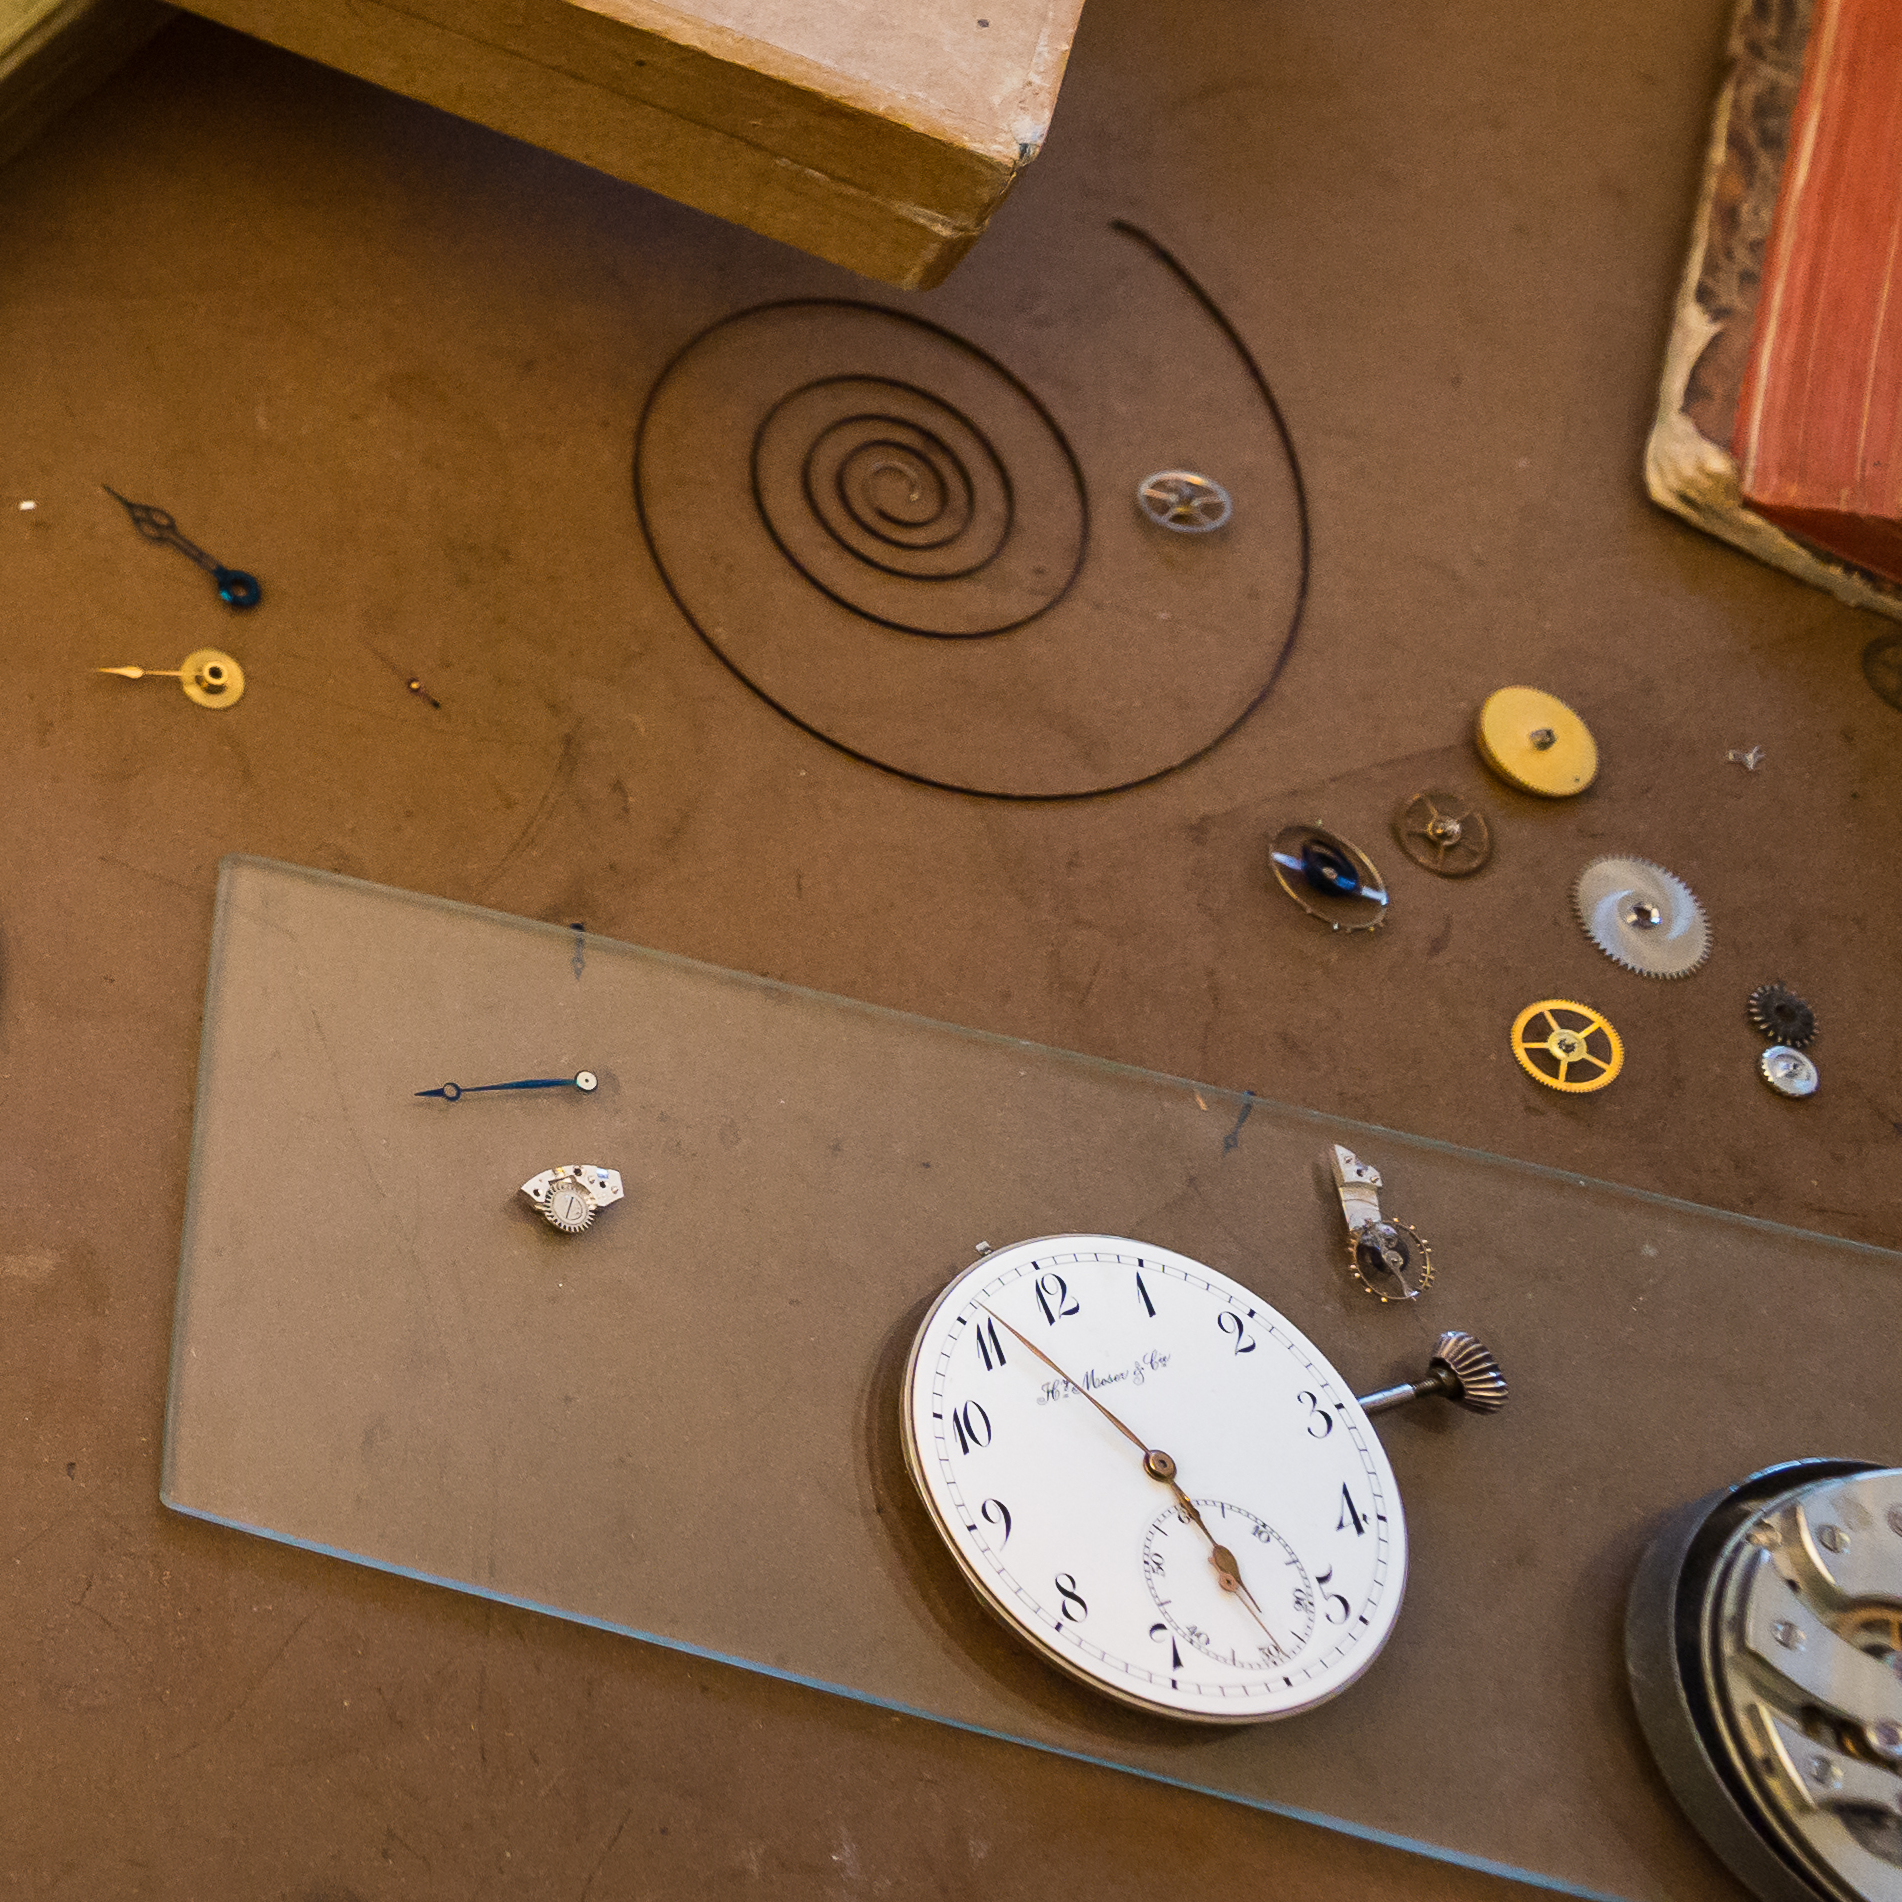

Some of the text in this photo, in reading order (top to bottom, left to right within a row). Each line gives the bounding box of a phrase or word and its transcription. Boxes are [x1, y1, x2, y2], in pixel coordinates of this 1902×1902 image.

[1034, 1272, 1080, 1327] 12
[1135, 1271, 1157, 1319] 1
[974, 1315, 1008, 1372] 11
[1217, 1310, 1257, 1356] 2
[951, 1398, 993, 1457] 10
[1296, 1391, 1334, 1439] 3
[980, 1498, 1012, 1552] 9
[1251, 1524, 1271, 1544] 10
[1335, 1482, 1371, 1538] 4
[1054, 1572, 1088, 1624] 8
[1316, 1563, 1351, 1626] 5
[1149, 1622, 1184, 1672] 7
